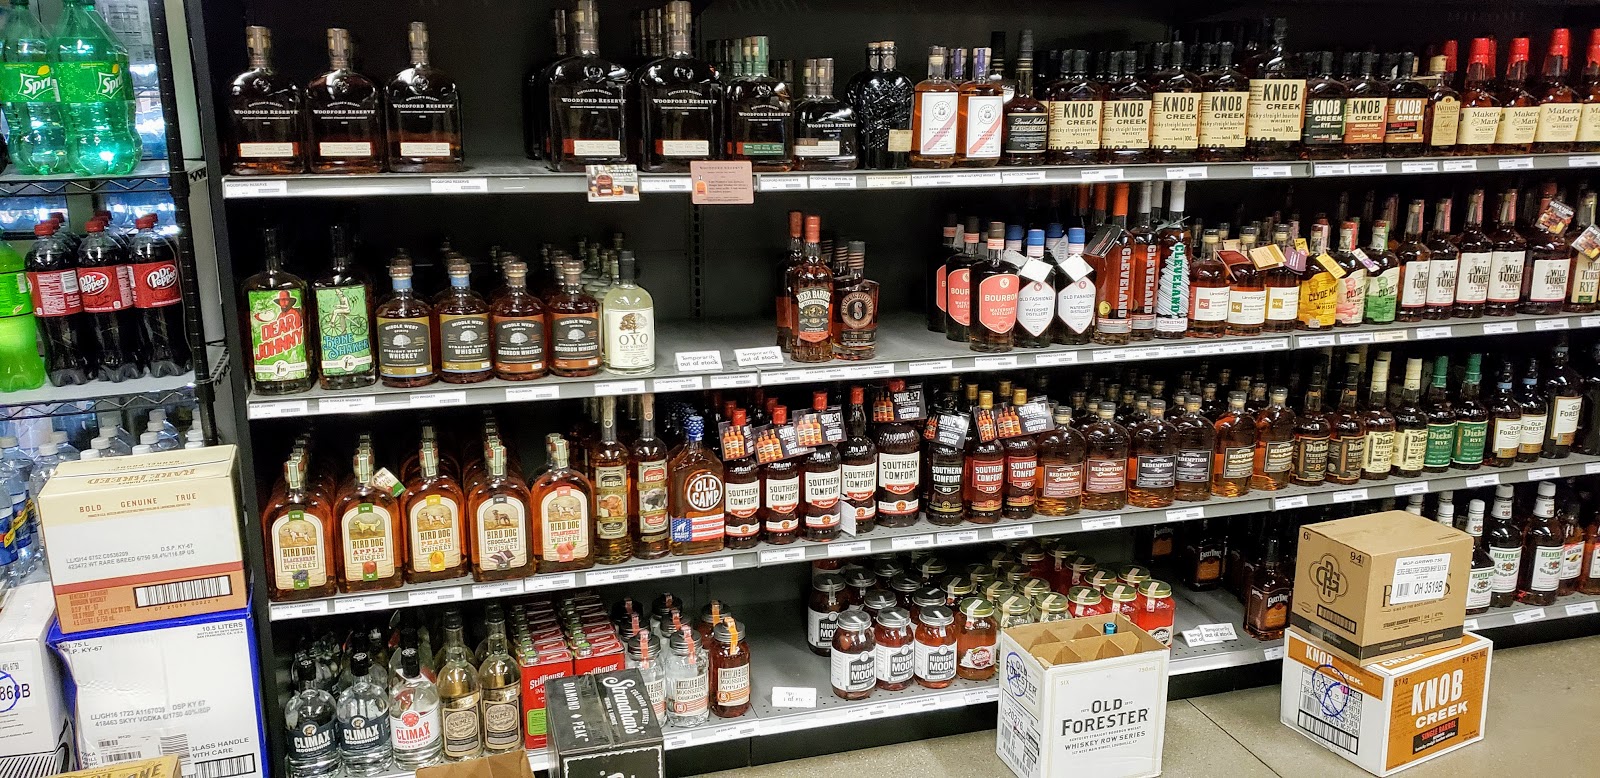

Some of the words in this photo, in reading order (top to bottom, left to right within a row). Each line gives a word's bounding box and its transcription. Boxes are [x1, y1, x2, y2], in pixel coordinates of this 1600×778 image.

[1263, 83, 1298, 101] KNOB
[1162, 96, 1194, 112] KNOB
[1211, 95, 1242, 112] KNOB
[1312, 99, 1340, 115] KNOB
[1352, 99, 1380, 114] KNOB
[1395, 99, 1421, 114] KNOB
[1063, 102, 1094, 118] KNOB
[1113, 102, 1144, 118] KNOB
[1472, 110, 1501, 119] Maker's
[149, 268, 178, 288] Pepper
[1145, 244, 1157, 314] CLEVELAND
[1549, 269, 1566, 278] WILD
[1118, 246, 1132, 318] CLEVELAND
[1171, 242, 1184, 318] CLEVELAND
[950, 287, 970, 295] BOUR
[1579, 281, 1595, 293] RYE
[984, 293, 1018, 302] BOURBON
[1308, 288, 1328, 302] CLYDE
[260, 313, 299, 342] DEAR
[255, 329, 304, 361] JOHNNY
[322, 332, 355, 350] BONE
[618, 333, 649, 345] OYO
[327, 339, 370, 360] SHAKER
[455, 347, 484, 355] WHISKEY
[521, 347, 542, 355] WHISKEY
[578, 344, 598, 352] WHISKEY
[388, 352, 418, 360] WHISKEY
[882, 459, 918, 470] SOUTHERN
[932, 466, 963, 475] SOUTHERN
[844, 468, 875, 479] SOUTHERN
[884, 469, 917, 480] COMFORT
[933, 473, 961, 482] COMFORT
[695, 477, 716, 491] OLD
[808, 476, 839, 487] SOUTHERN
[846, 477, 875, 487] COMFORT
[728, 487, 758, 498] SOUTHERN
[769, 482, 798, 494] SOUTHERN
[810, 484, 839, 496] COMFORT
[692, 489, 719, 508] CAMP
[730, 496, 758, 506] COMFORT
[771, 491, 798, 501] COMFORT
[79, 505, 102, 513] BOLD
[121, 497, 158, 508] GENUINE
[175, 493, 197, 502] TRUE
[550, 522, 566, 531] BIRD
[567, 520, 580, 529] DOG
[420, 530, 438, 539] BIRD
[438, 528, 451, 538] DOG
[487, 530, 503, 539] BIRD
[504, 528, 517, 537] DOG
[352, 538, 370, 549] BIRD
[370, 537, 384, 547] DOG
[283, 547, 300, 557] BIRD
[302, 546, 316, 556] DOG
[1350, 551, 1362, 561] 94
[1414, 582, 1424, 595] OH
[1424, 580, 1444, 594] 3519B
[217, 621, 243, 630] LITERS
[1305, 645, 1333, 666] KNOB
[851, 663, 874, 672] MIDNIGHT
[892, 661, 914, 672] MOON
[929, 661, 953, 671] MOON
[851, 670, 874, 681] MOON
[1411, 668, 1464, 716] KNOB
[172, 703, 186, 711] DSP
[187, 701, 197, 709] KY
[563, 682, 581, 711] DIAMOND
[572, 720, 587, 739] PEAK
[602, 676, 640, 735] Stranahan's
[1091, 698, 1122, 714] OLD
[119, 709, 134, 717] 1723
[641, 707, 650, 725] WHISKEY
[1415, 700, 1469, 729] CREEK
[119, 716, 136, 725] SKYY
[139, 714, 161, 723] VODKA
[1060, 708, 1149, 736] FORESTER
[344, 725, 380, 741] CLIMAX
[396, 722, 431, 740] CLIMAX
[1421, 728, 1438, 740] SINGLE
[217, 736, 250, 748] HANDLE
[294, 732, 331, 748] CLIMAX
[345, 736, 380, 745] MOONSHINE
[1064, 739, 1099, 751] WHISKEY
[1100, 736, 1118, 745] ROW
[1119, 730, 1146, 742] SERIES
[211, 747, 234, 756] CARE
